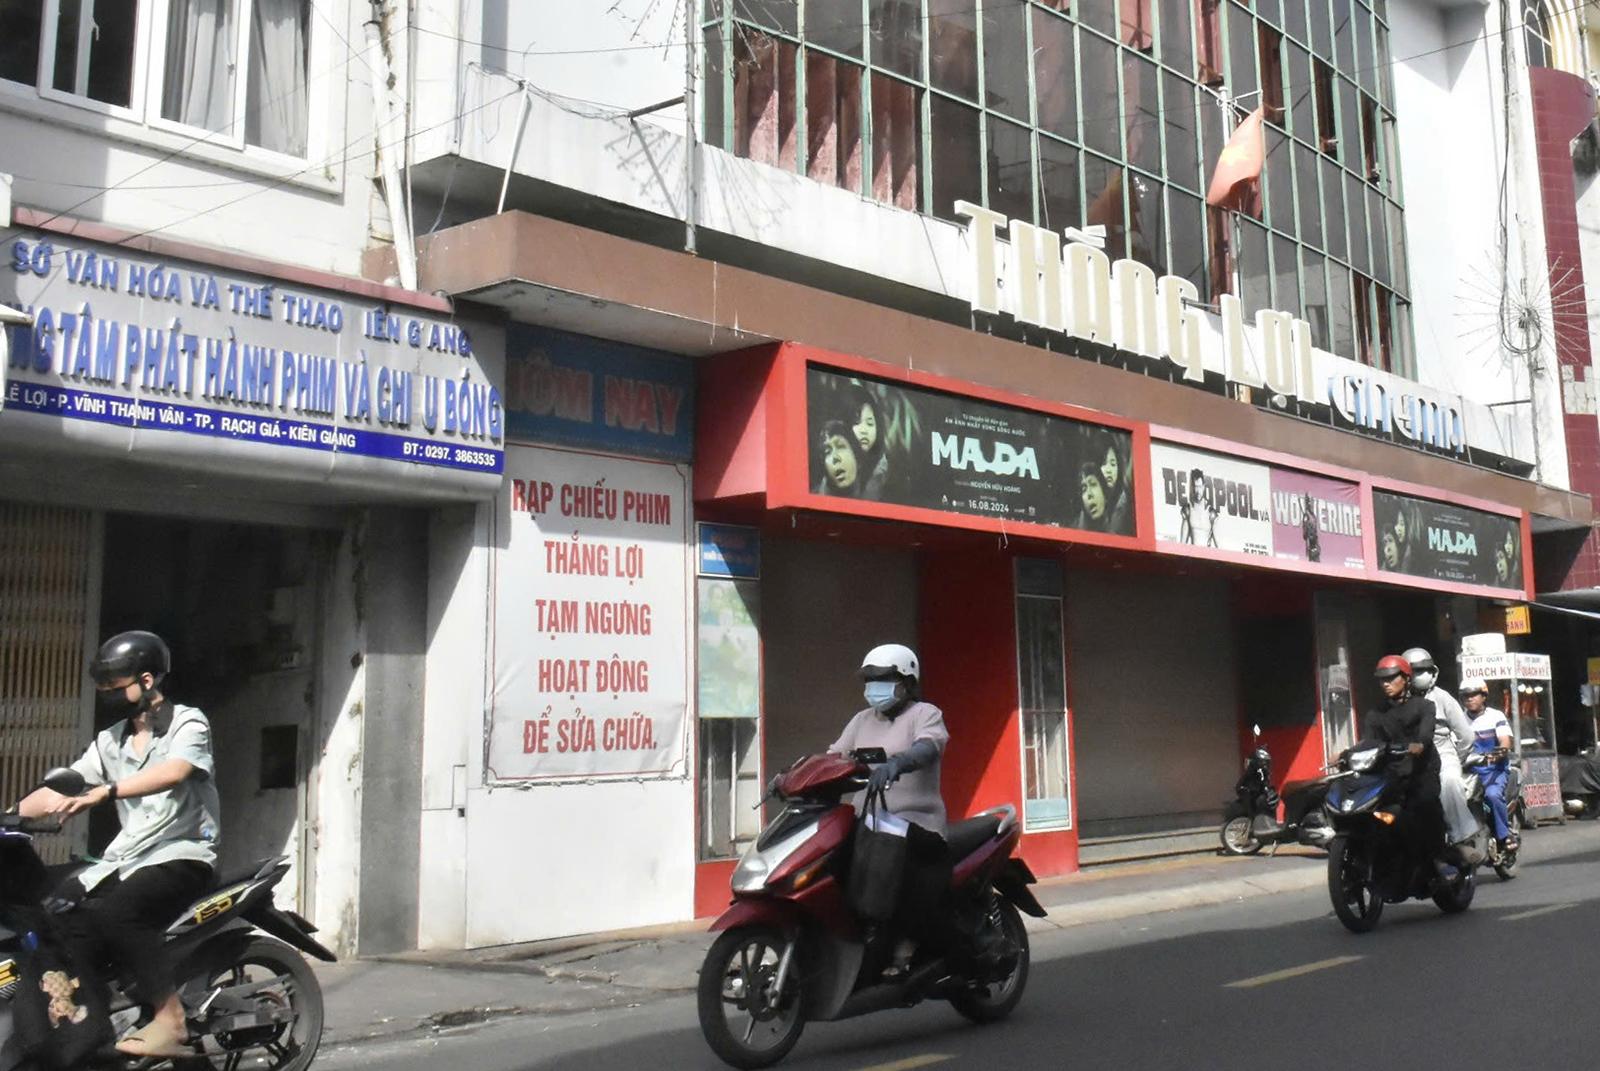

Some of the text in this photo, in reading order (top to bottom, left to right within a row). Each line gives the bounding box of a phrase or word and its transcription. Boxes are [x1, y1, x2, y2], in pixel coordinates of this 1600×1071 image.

[128, 263, 181, 307] HÓA
[190, 272, 220, 310] VÀ
[281, 294, 344, 334] THAO
[58, 301, 120, 382] TÂM
[123, 316, 200, 400] PHÁT
[202, 326, 276, 410] HÀNH
[279, 349, 338, 417] PHIM
[342, 350, 372, 424] VÀ
[443, 368, 504, 443] BÓNG
[159, 406, 184, 425] VÂN
[194, 412, 215, 430] TP.
[221, 416, 256, 437] RẠCH
[289, 423, 317, 443] KIÊN
[320, 430, 356, 448] GIANG
[605, 373, 684, 436] NAY
[455, 449, 496, 467] 3863535
[512, 477, 671, 526] RẠP CHIẾU PHIM
[968, 498, 1010, 513] 16.08.2024
[544, 529, 644, 586] THẮNG LỢI
[535, 598, 651, 641] TẠM NGƯNG
[538, 652, 649, 700] HOẠT ĐỘNG
[523, 704, 552, 754] ĐỂ
[556, 707, 596, 754] SỬA
